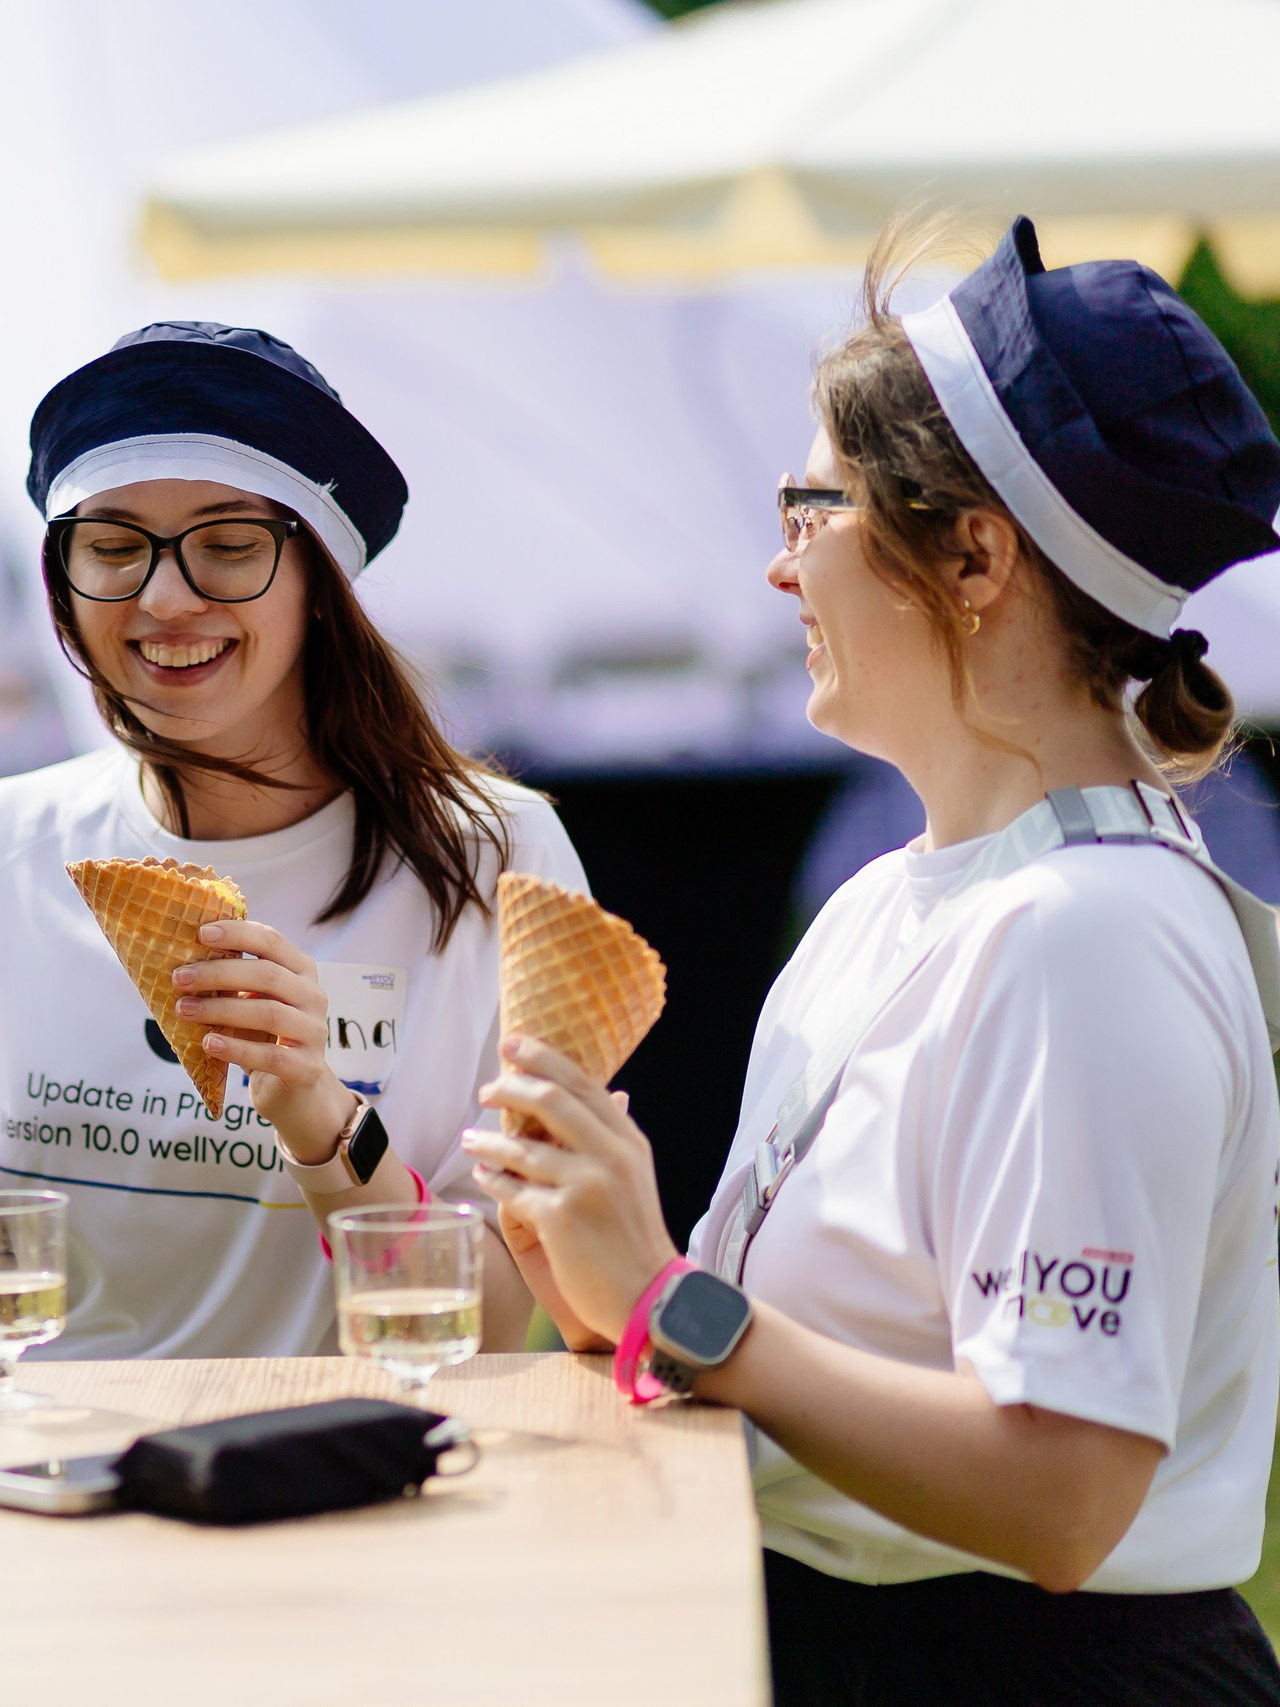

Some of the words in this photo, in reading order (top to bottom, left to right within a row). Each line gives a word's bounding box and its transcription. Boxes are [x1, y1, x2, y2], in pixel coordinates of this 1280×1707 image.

[27, 1072, 134, 1112] Update
[141, 1088, 168, 1117] in
[81, 1123, 140, 1156] 10.0
